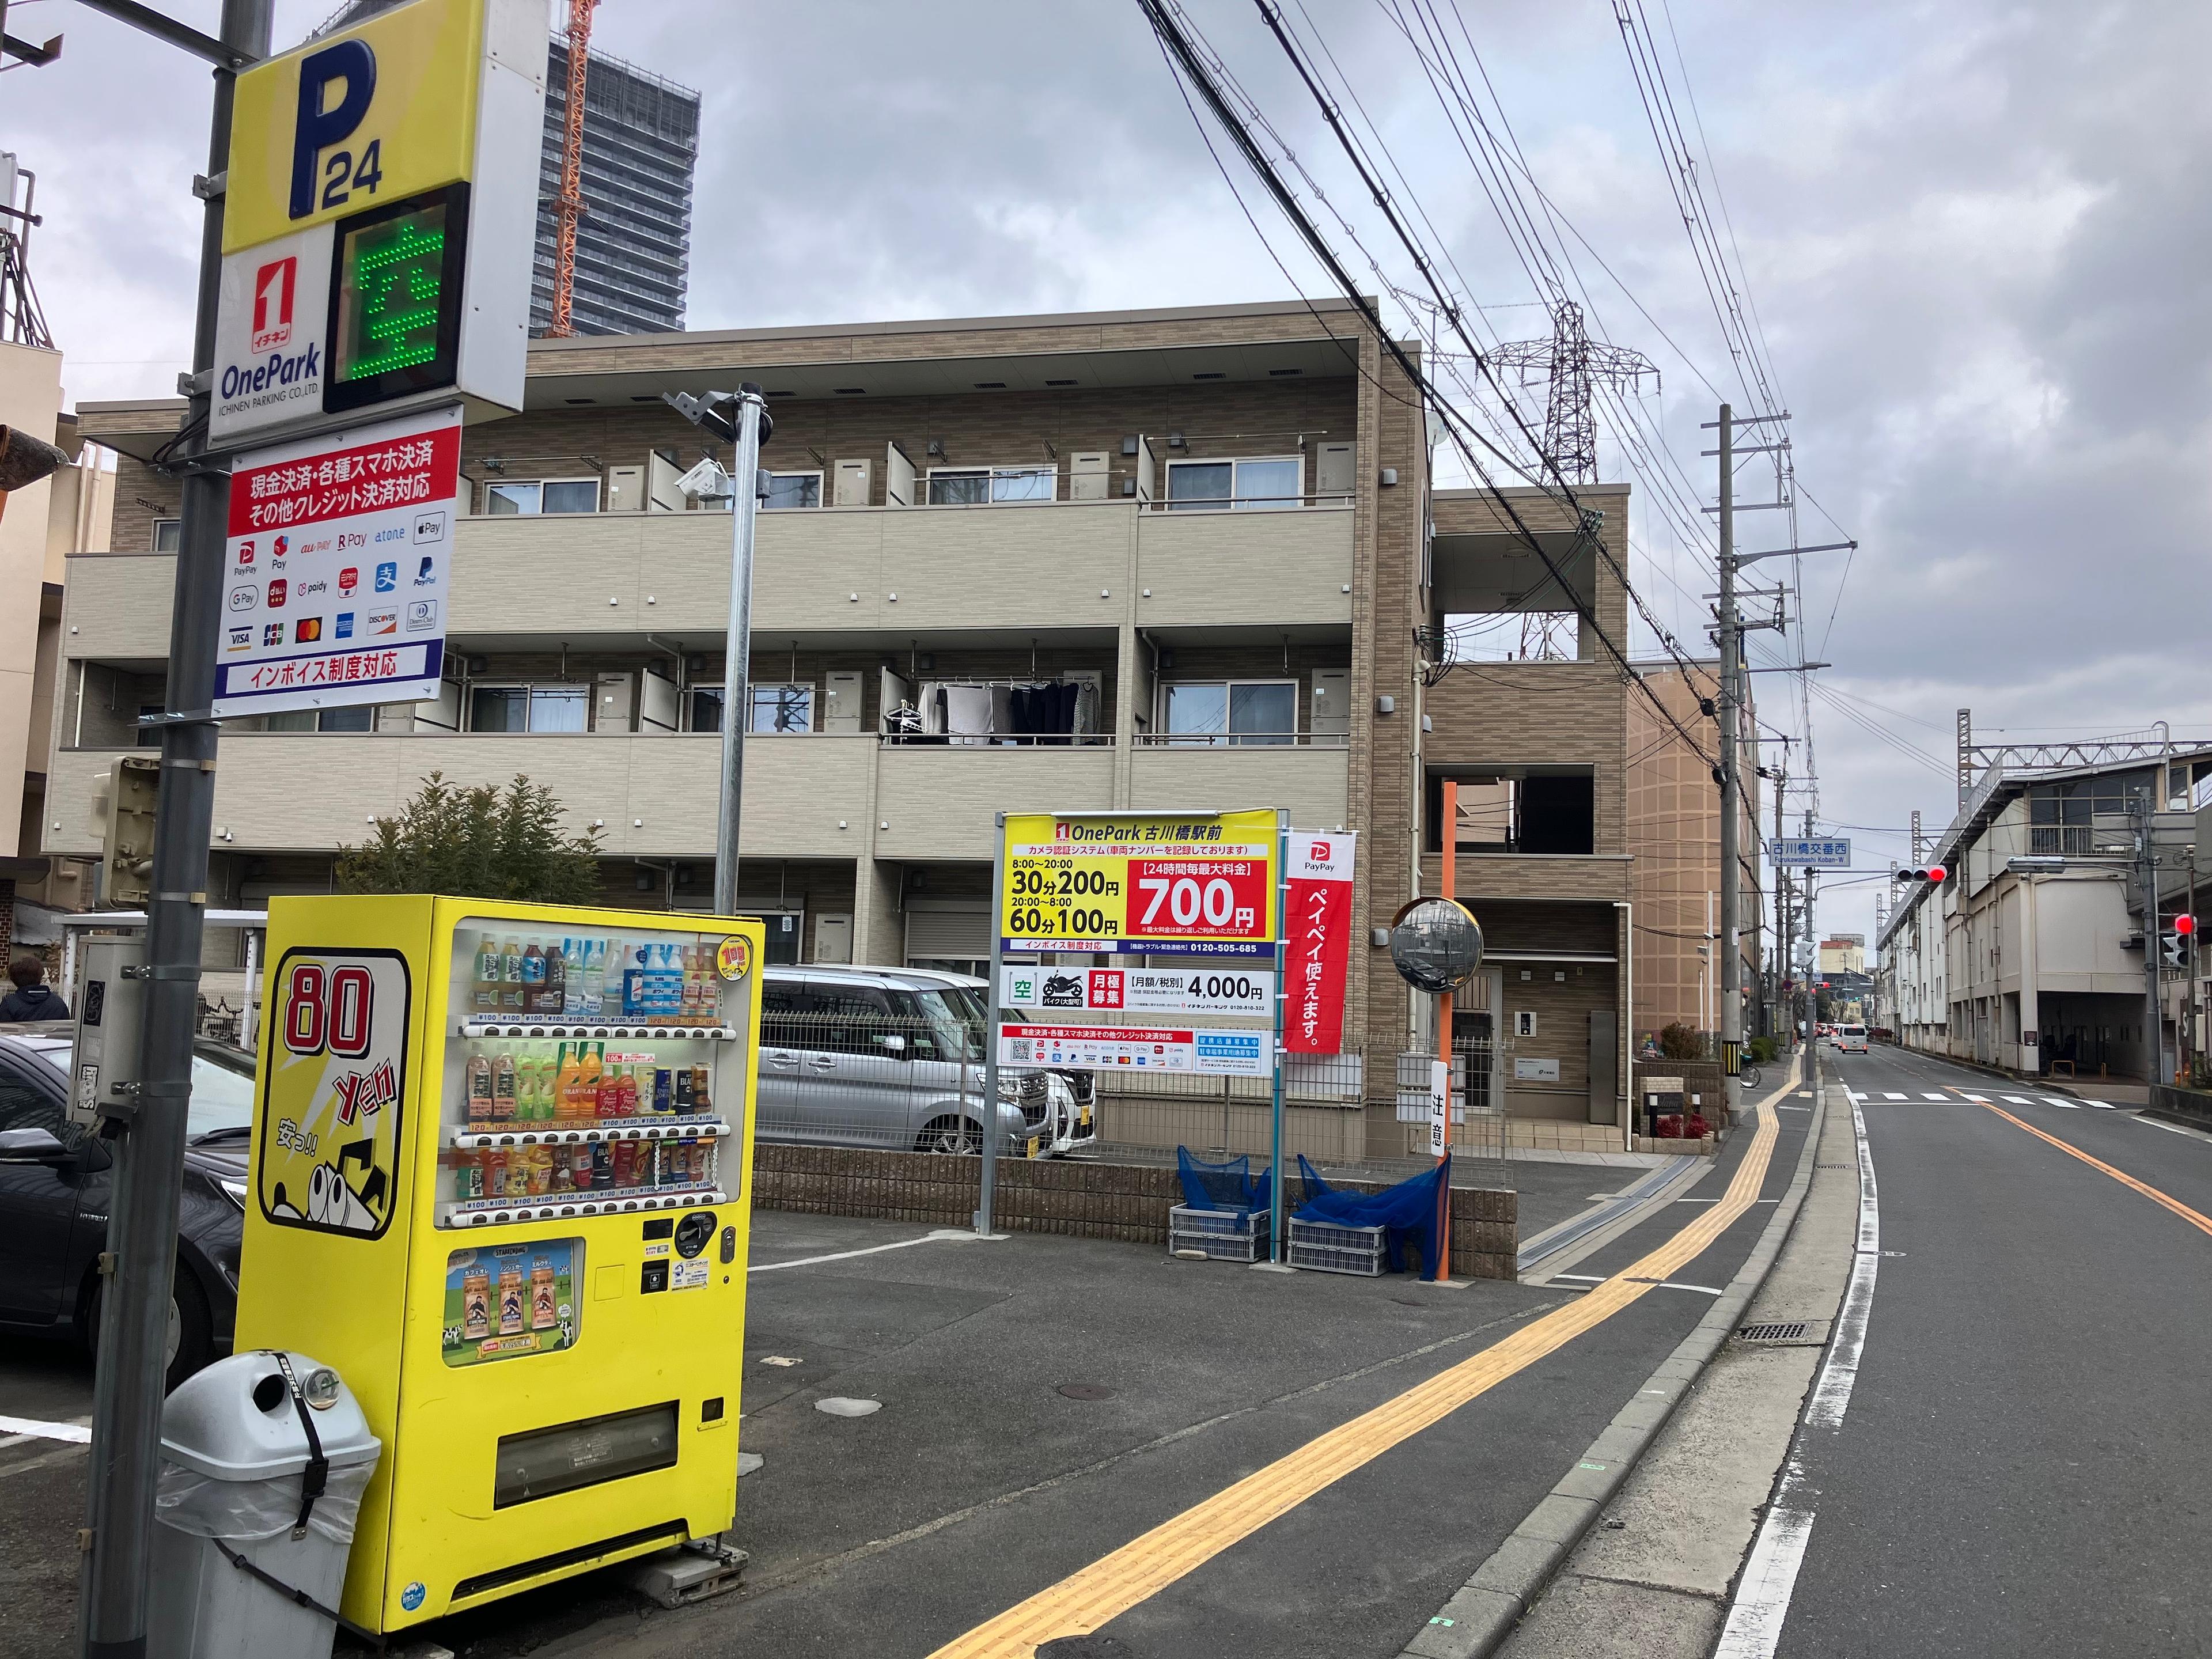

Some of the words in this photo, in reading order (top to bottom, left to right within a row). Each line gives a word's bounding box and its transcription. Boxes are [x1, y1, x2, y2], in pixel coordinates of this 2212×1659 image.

[289, 39, 377, 221] P
[322, 139, 382, 210] 24
[352, 225, 444, 380] 空
[255, 328, 288, 348] イチネン
[221, 342, 321, 399] OnePark
[218, 401, 249, 416] ICHINEN
[252, 390, 286, 408] PARKING
[250, 440, 433, 499] 現金決済・各種スマホ決済
[249, 472, 431, 527] その他クレジット決済対応
[375, 528, 405, 542] atone
[425, 522, 441, 535] Pay
[301, 543, 316, 553] au
[317, 540, 331, 551] PAY
[348, 533, 368, 547] Pay
[234, 566, 257, 576] PayPay
[272, 559, 287, 570] Pay
[308, 581, 328, 595] paidy
[414, 577, 436, 586] PayPal
[241, 593, 253, 605] Pay
[369, 614, 396, 624] DISCOVER
[232, 634, 249, 644] VISA
[263, 630, 282, 639] JCB
[251, 651, 397, 688] インボイス制度対応
[1072, 824, 1141, 841] OnePark
[1145, 825, 1223, 842] 古川橋駅前
[1773, 843, 1847, 854] 古川橋交番西
[1142, 862, 1251, 877] 【24時間毎最大料金】
[1305, 862, 1335, 872] PayPay
[1012, 870, 1119, 896] 30分200円
[1139, 878, 1255, 928] 700円
[1010, 908, 1118, 935] 60分100円
[1025, 941, 1102, 950] インボイス制度対応
[1191, 944, 1256, 953] 0120-505-685
[722, 946, 744, 965] 100
[1302, 888, 1327, 1046] ペイペイ使えます。
[1094, 974, 1120, 988] 月極
[1130, 976, 1183, 988] 【月額/税別】
[1188, 976, 1263, 1000] 4,000円
[1014, 980, 1032, 998] 空
[1044, 997, 1082, 1006] バイク(大型可)
[1093, 990, 1119, 1005] 募集
[283, 964, 374, 1059] 80
[1021, 1028, 1173, 1040] 現金決済・各種スマホ決済その他クレジット決済対応
[1433, 1094, 1444, 1147] 注意
[276, 1118, 317, 1157] 安っ!!
